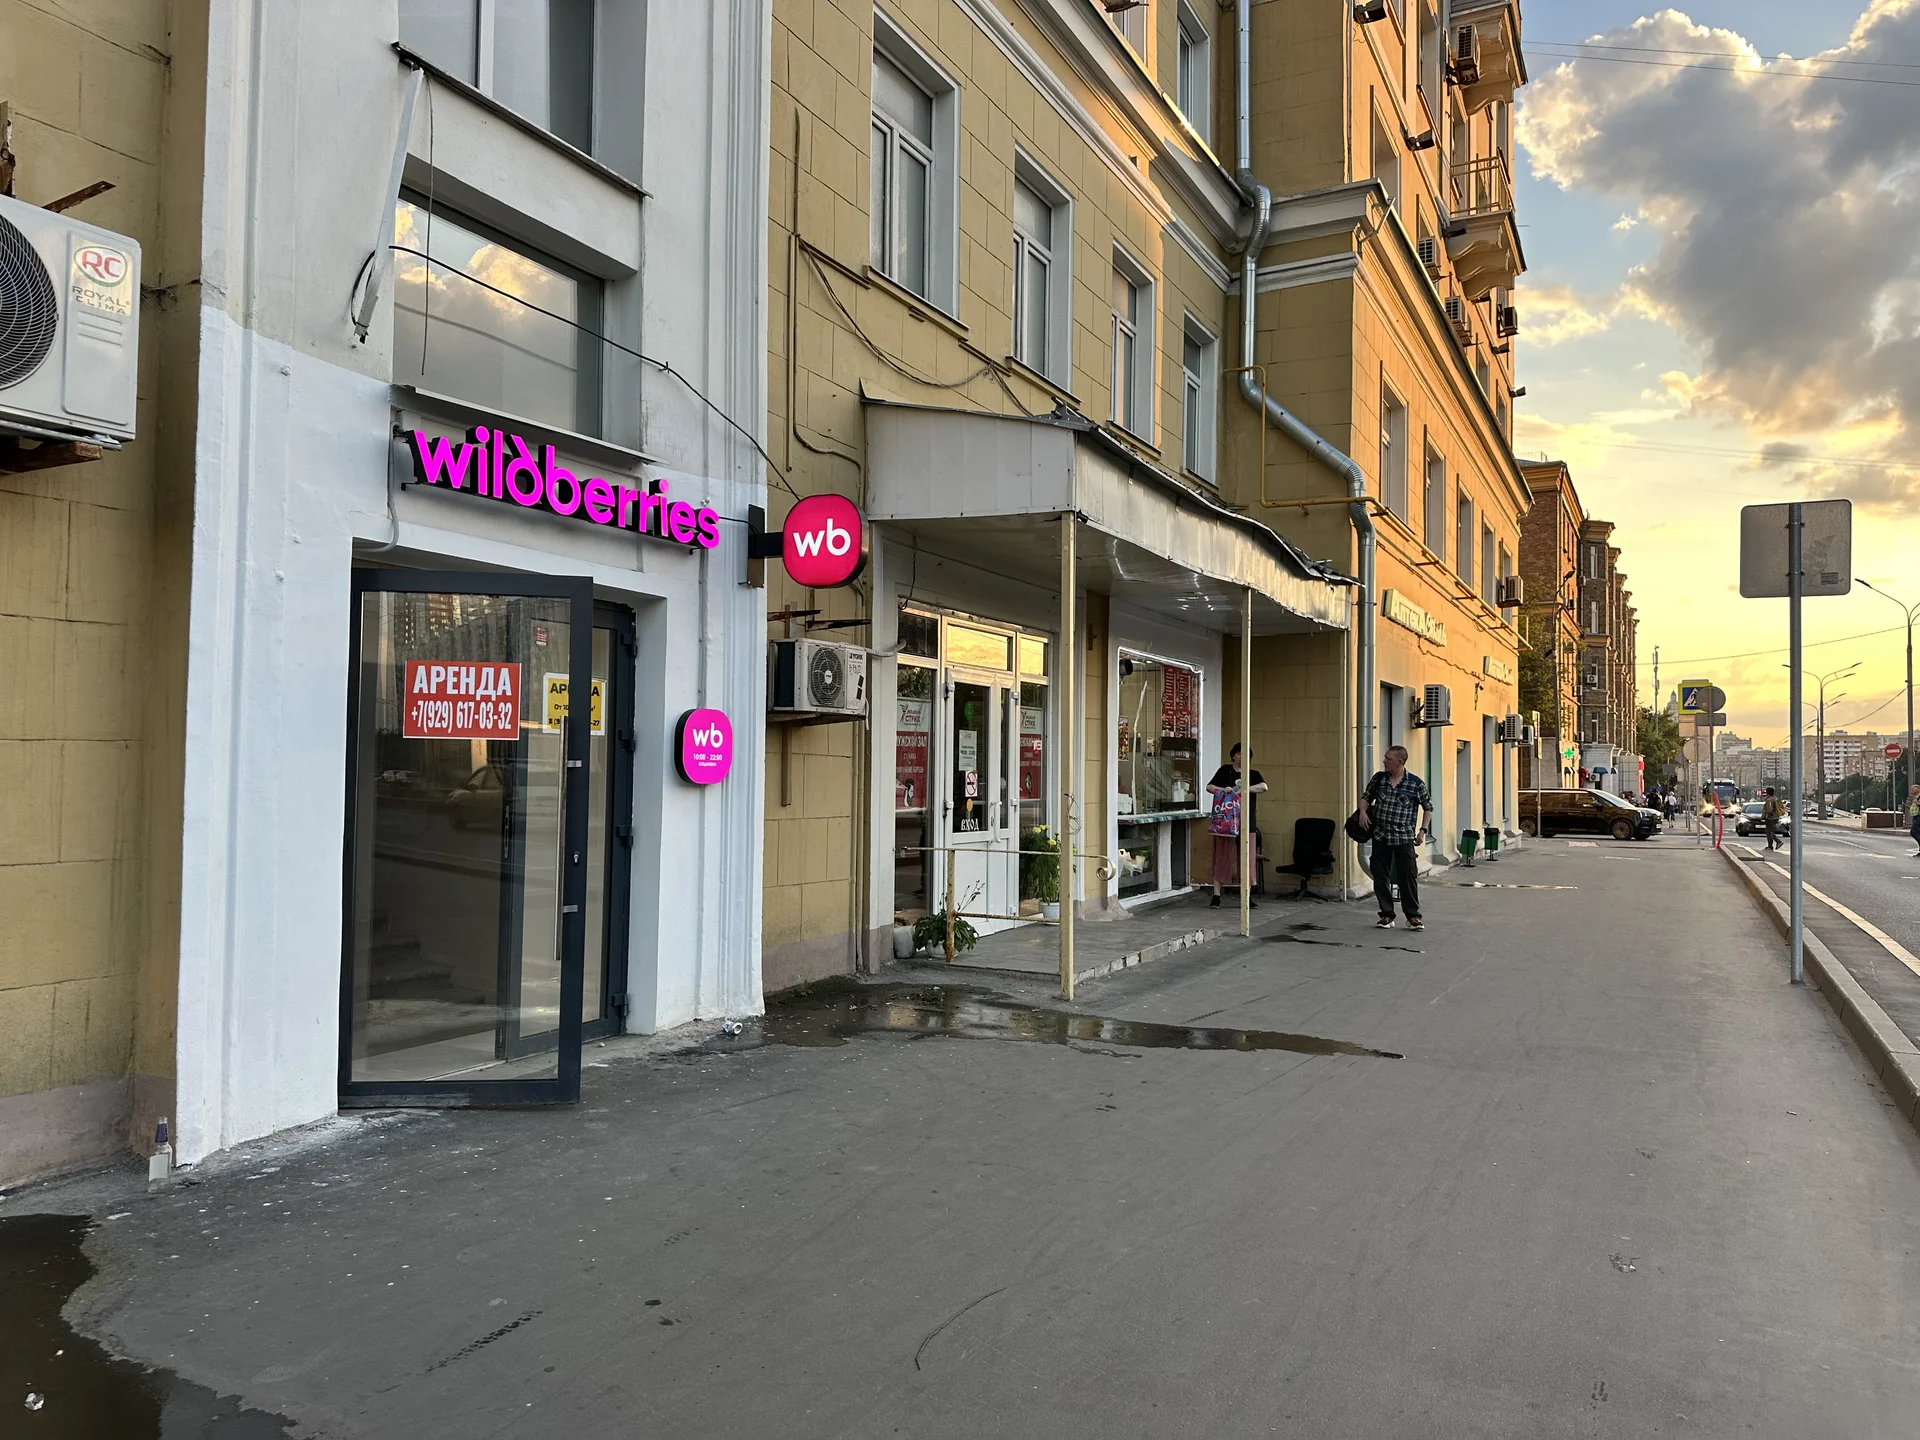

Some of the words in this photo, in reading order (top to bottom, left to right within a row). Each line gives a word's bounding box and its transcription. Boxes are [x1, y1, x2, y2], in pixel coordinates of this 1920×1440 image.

[82, 250, 121, 279] RC
[72, 286, 126, 307] ROYAL
[76, 296, 126, 315] CLIMA
[413, 425, 720, 549] wildberries
[793, 518, 851, 557] wb
[413, 665, 512, 700] АРЕНДА
[411, 700, 453, 733] +7(929)
[456, 701, 511, 730] 617-03-32
[692, 722, 723, 748] wb
[961, 818, 980, 831] ВХОД
